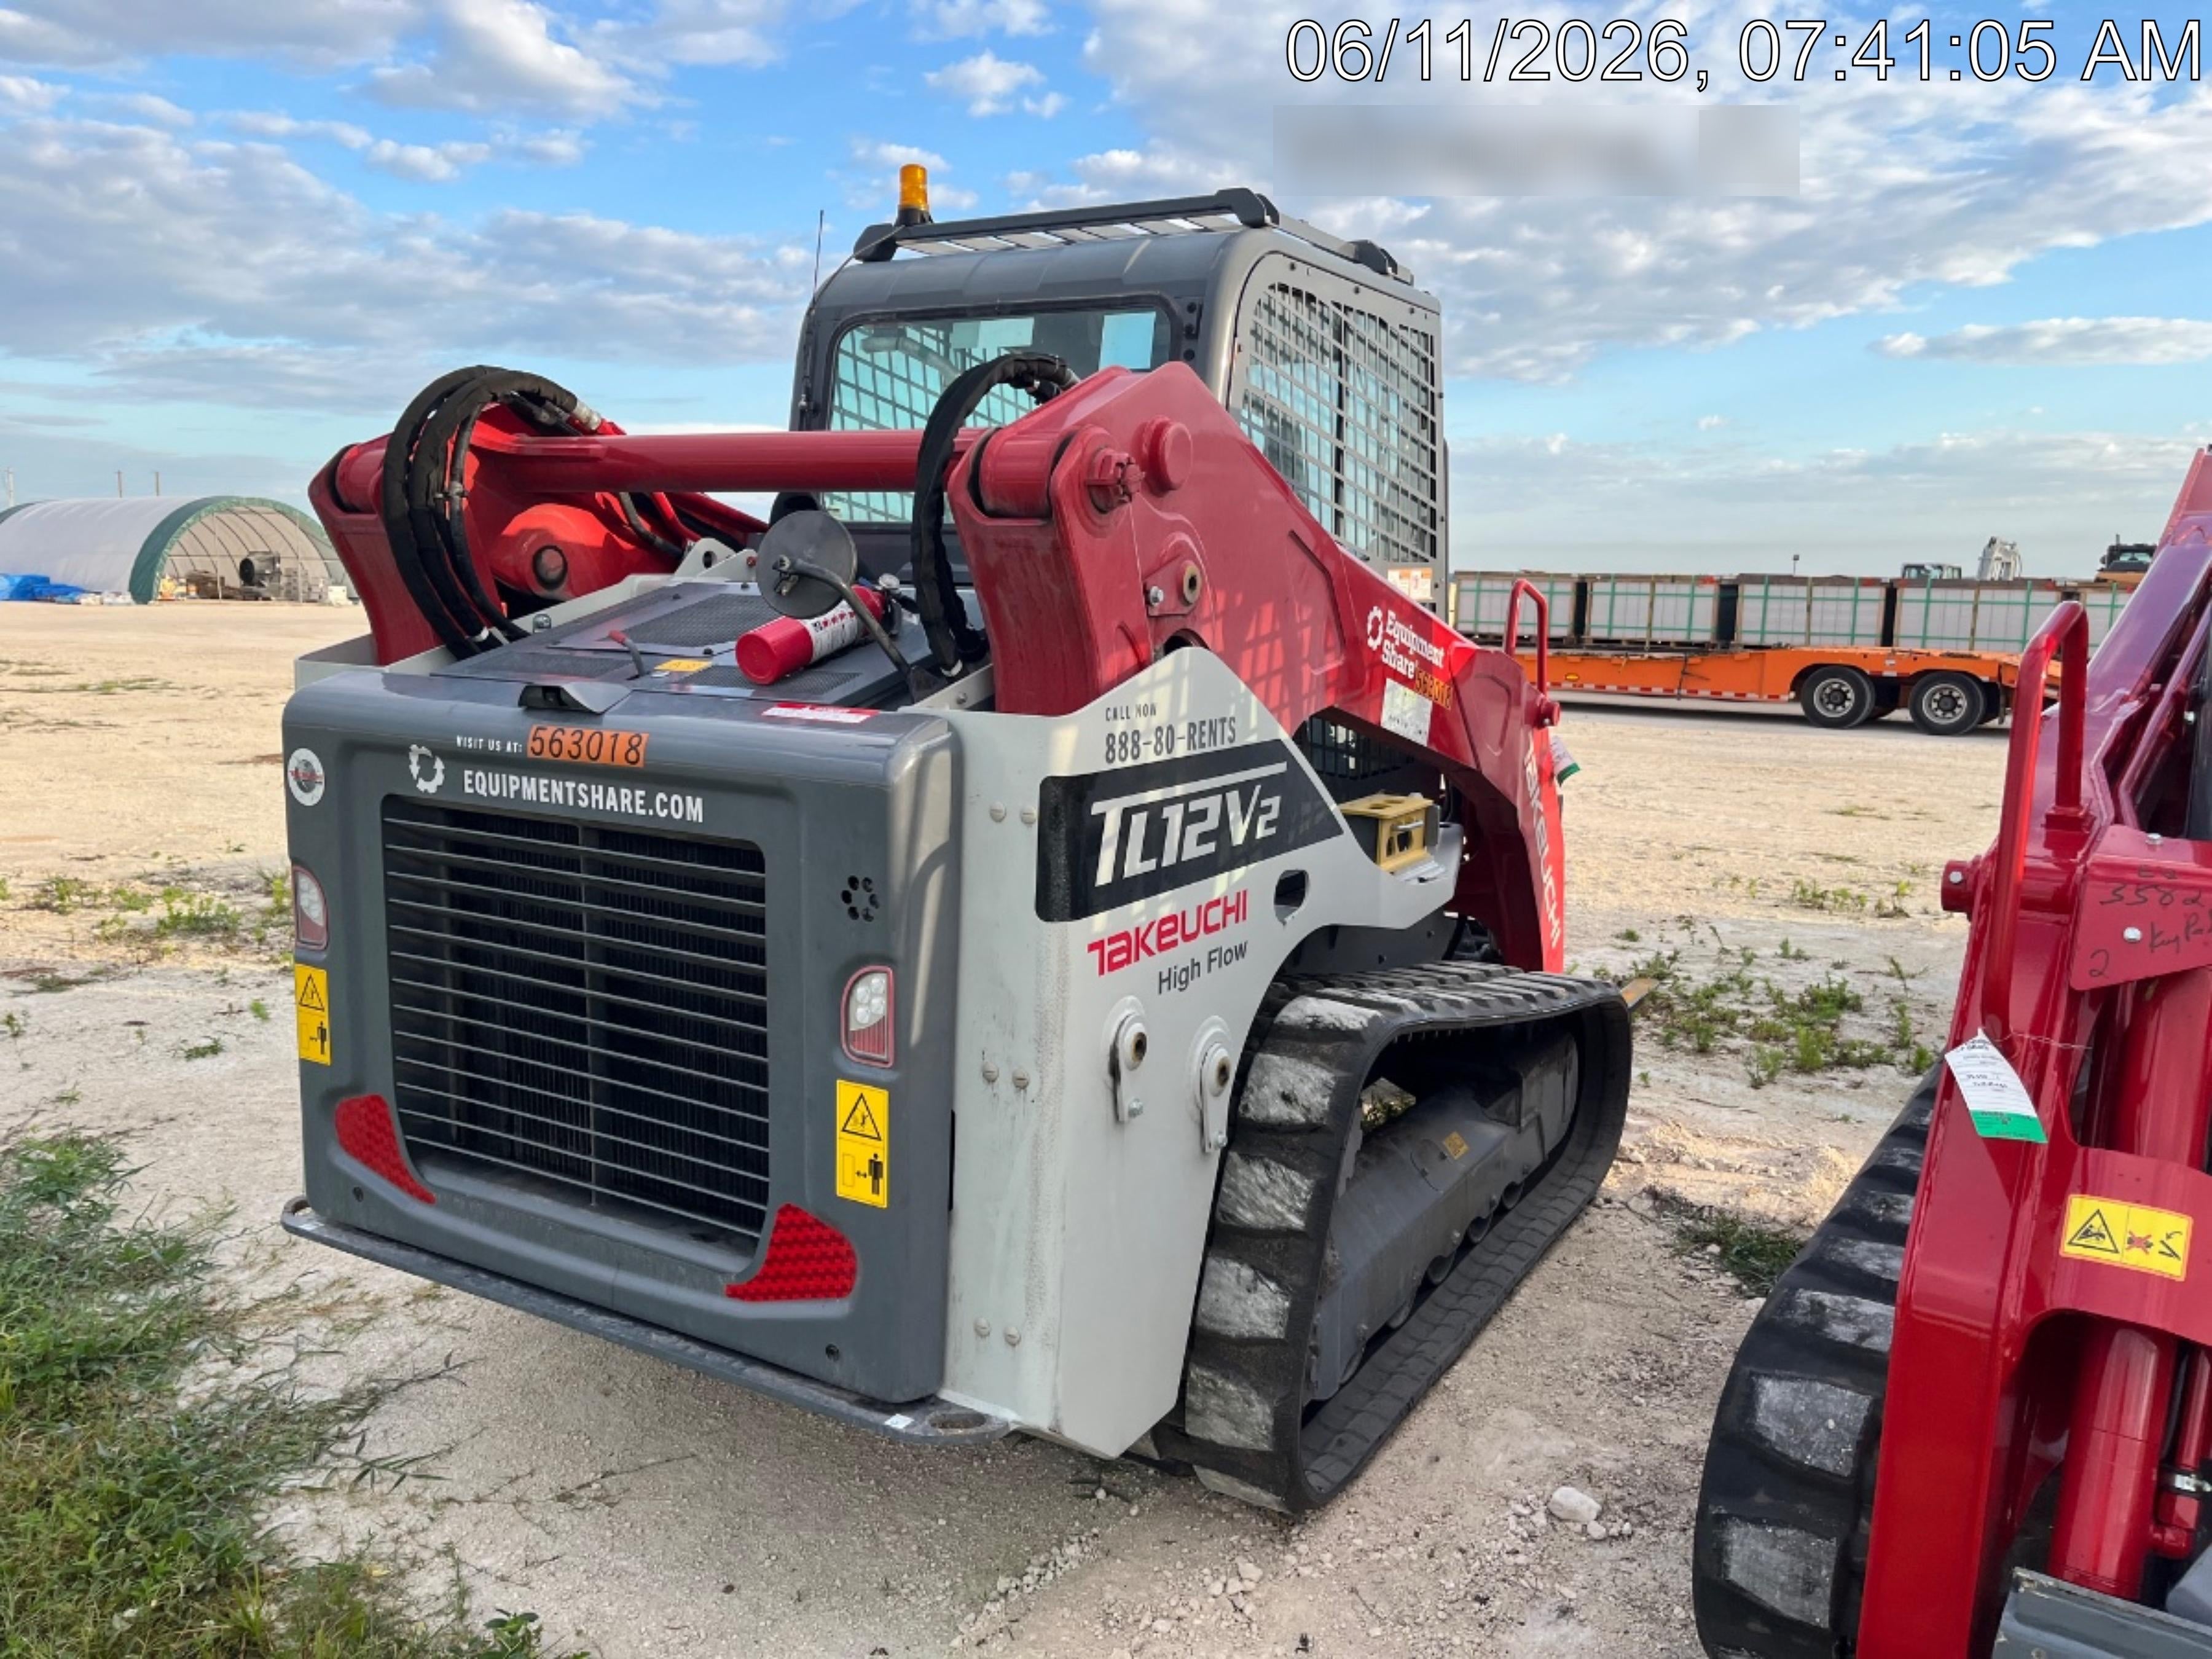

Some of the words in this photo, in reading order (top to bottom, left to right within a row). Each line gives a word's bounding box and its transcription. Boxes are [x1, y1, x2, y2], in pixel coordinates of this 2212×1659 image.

[1382, 639, 1414, 680] Share
[1386, 610, 1445, 668] Equipment
[1105, 706, 1130, 721] CALL
[1135, 704, 1156, 718] NOW
[457, 735, 483, 749] VISIT
[488, 739, 500, 751] US
[506, 741, 522, 753] AT:
[530, 726, 642, 766] 563018
[1105, 716, 1236, 764] 888-80-RENTS
[463, 770, 703, 823] EQUIPMENTSHARE.COM
[1158, 958, 1201, 994] High
[1207, 940, 1249, 974] Flow
